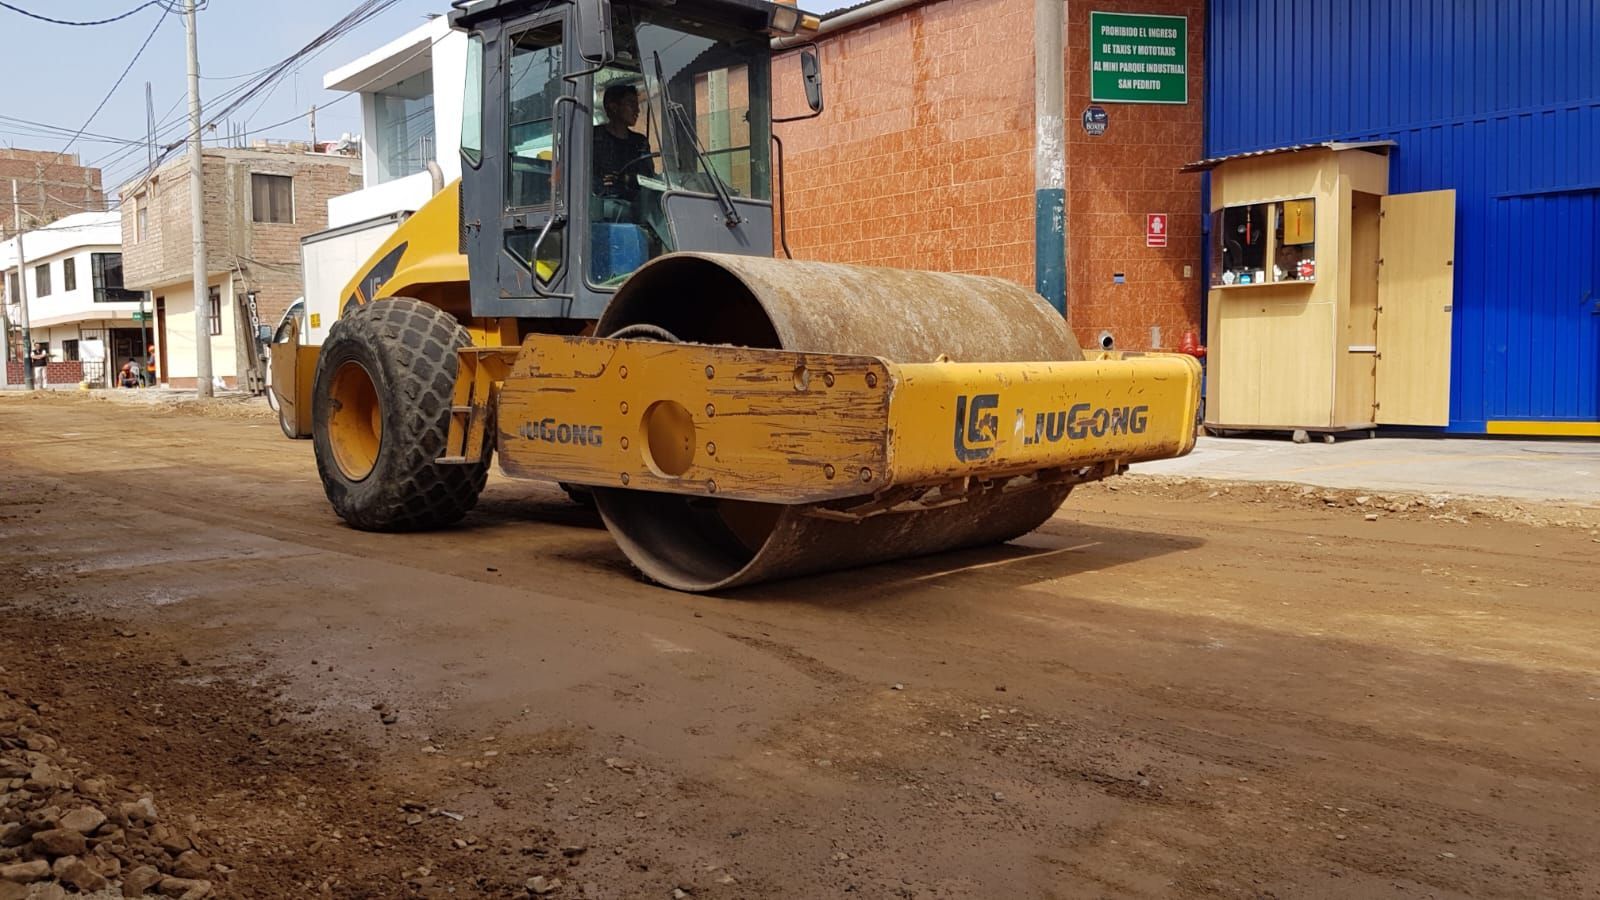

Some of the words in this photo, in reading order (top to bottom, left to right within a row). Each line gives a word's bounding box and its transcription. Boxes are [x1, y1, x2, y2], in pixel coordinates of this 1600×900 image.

[1101, 25, 1138, 37] PROHIBIDO
[1139, 27, 1147, 37] EL
[1148, 27, 1177, 39] INGRESO
[1102, 43, 1111, 54] DE
[1112, 44, 1131, 55] TAXIS
[1132, 45, 1137, 55] Y
[1138, 45, 1176, 57] MOTOTAXIS
[1093, 61, 1102, 71] AL
[1102, 61, 1118, 72] MINI
[1119, 62, 1145, 73] PARQUE
[1146, 63, 1185, 74] INDUSTRIAL
[1118, 79, 1132, 89] SAN
[1132, 79, 1161, 90] PEDRITO
